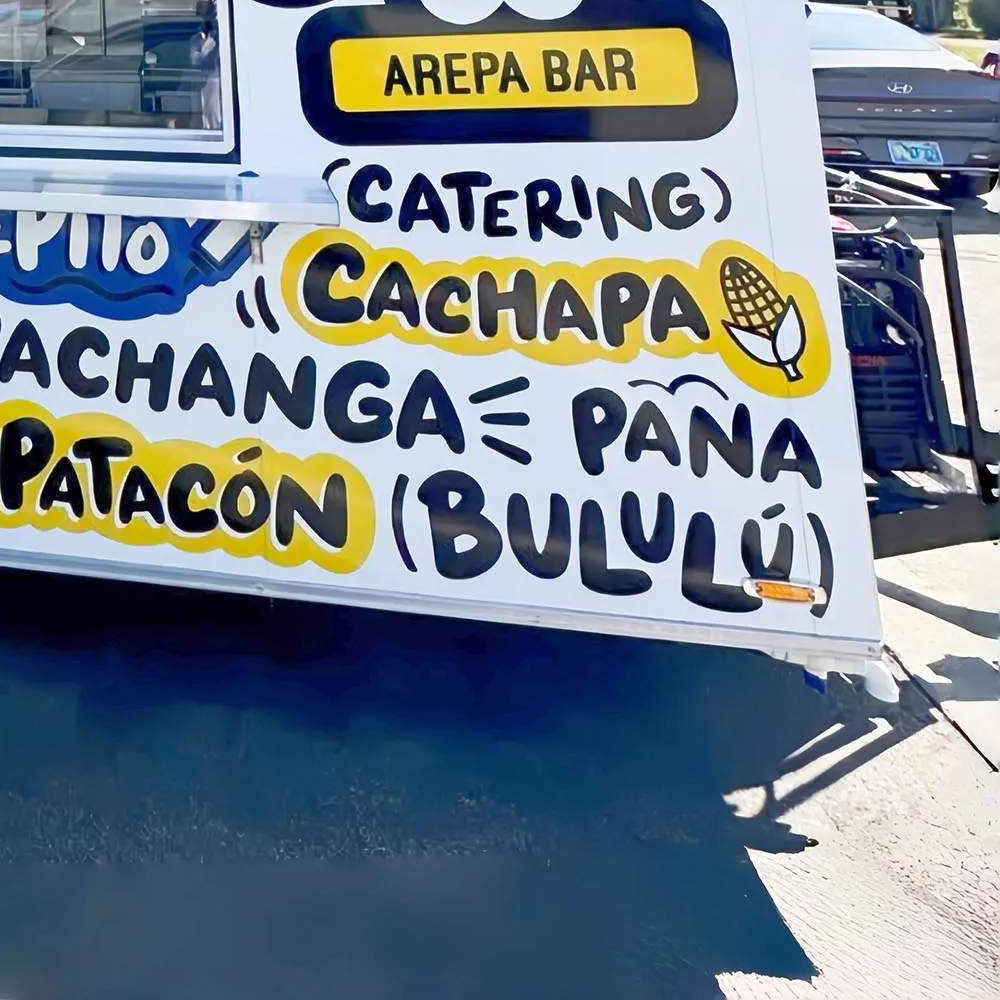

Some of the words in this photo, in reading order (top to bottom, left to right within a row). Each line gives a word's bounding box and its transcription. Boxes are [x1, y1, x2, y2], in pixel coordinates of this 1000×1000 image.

[384, 54, 529, 97] AREPA
[545, 47, 637, 92] BAR
[303, 242, 711, 347] CACHAPA
[0, 416, 349, 549] PATACÓN
